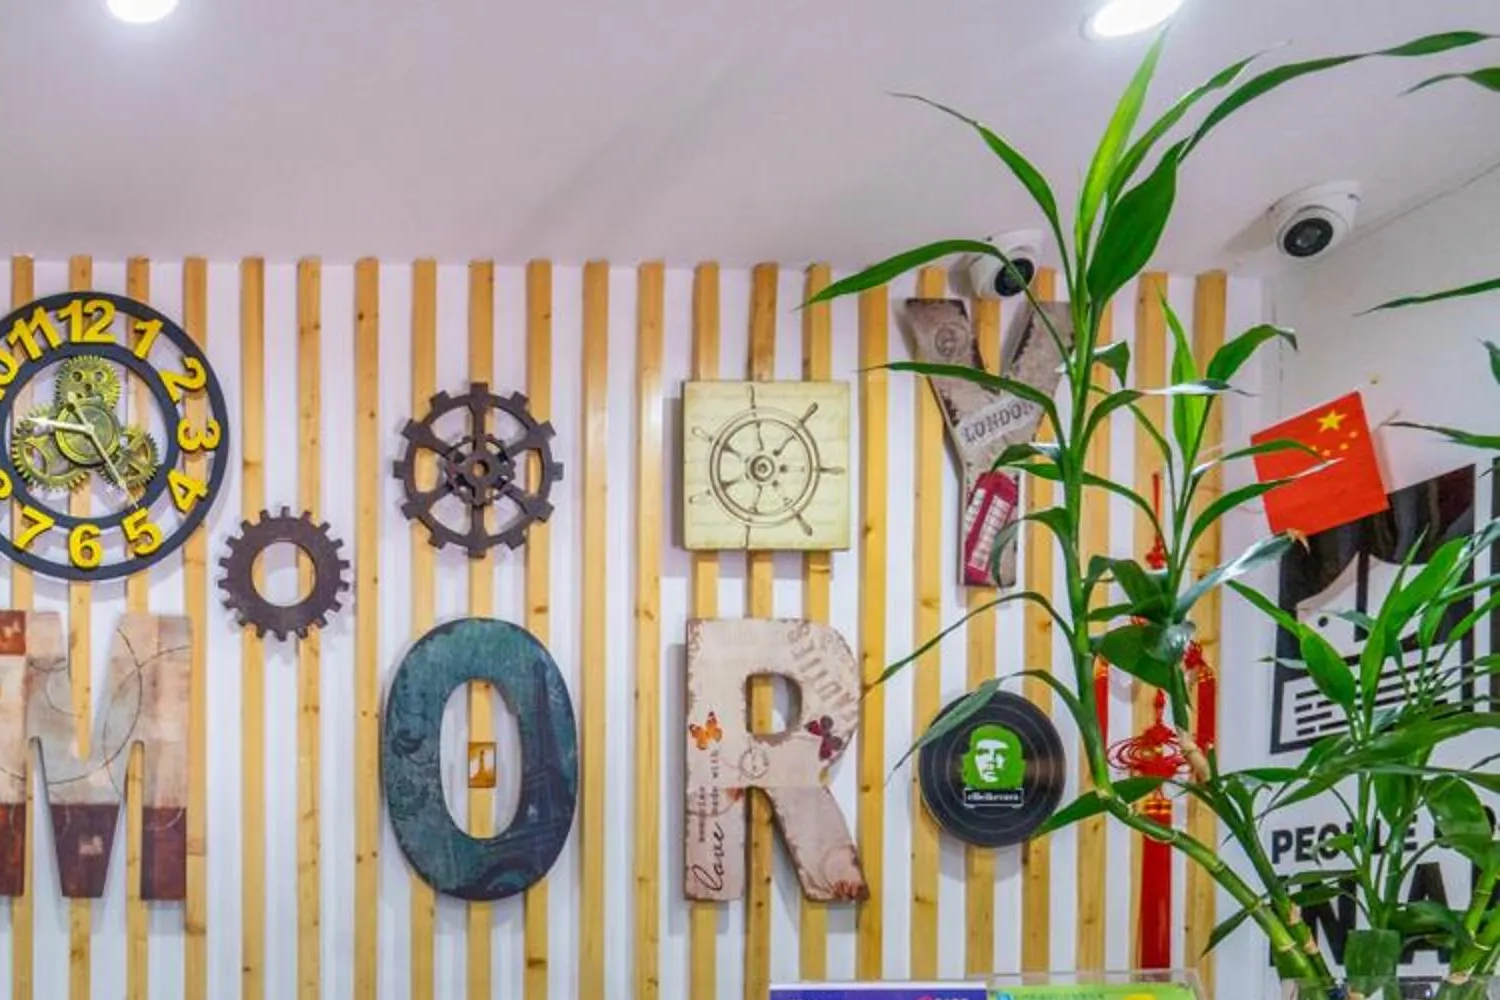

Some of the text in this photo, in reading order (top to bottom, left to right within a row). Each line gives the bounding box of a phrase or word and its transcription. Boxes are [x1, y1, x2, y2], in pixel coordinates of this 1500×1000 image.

[6, 306, 62, 361] 11
[57, 300, 117, 343] 12
[133, 319, 164, 360] 1
[158, 356, 208, 402] 2
[177, 418, 221, 452] 3
[167, 468, 209, 513] 4
[13, 505, 56, 550] 7
[68, 523, 102, 569] 6
[121, 507, 163, 555] 5
